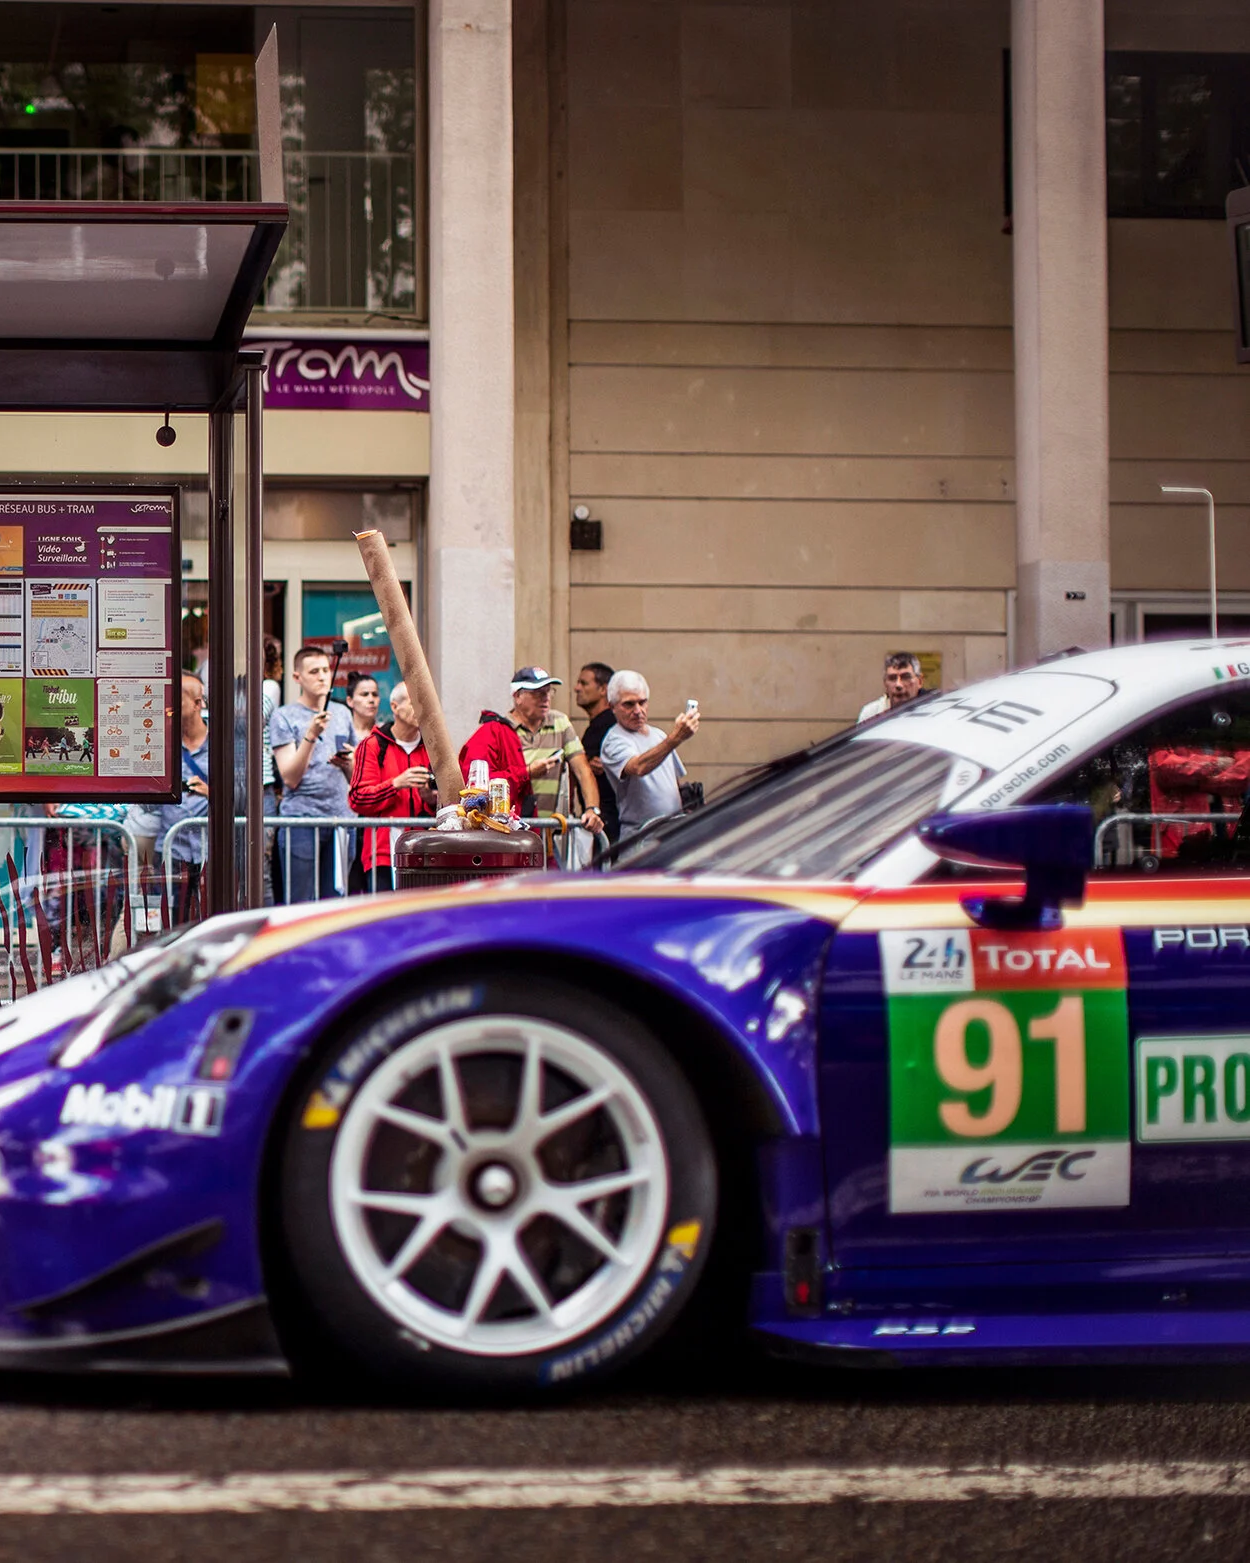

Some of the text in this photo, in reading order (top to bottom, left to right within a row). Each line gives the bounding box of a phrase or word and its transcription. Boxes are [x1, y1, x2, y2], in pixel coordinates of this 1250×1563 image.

[276, 384, 290, 394] LE
[294, 384, 325, 394] MANS
[37, 504, 57, 514] BUS
[67, 504, 95, 514] TRAM
[37, 544, 62, 553] Vidéo
[37, 554, 88, 563] Surveillance
[48, 689, 79, 705] tribu
[902, 937, 966, 969] 24h
[900, 970, 964, 981] LE MANS
[932, 995, 1087, 1138] 91
[59, 1082, 177, 1130] Mobil
[960, 1150, 1097, 1184] WEC
[943, 1189, 979, 1197] WORLD
[965, 1194, 1042, 1204] CHAMPIONSHIP
[551, 1277, 673, 1383] MICHELIN
